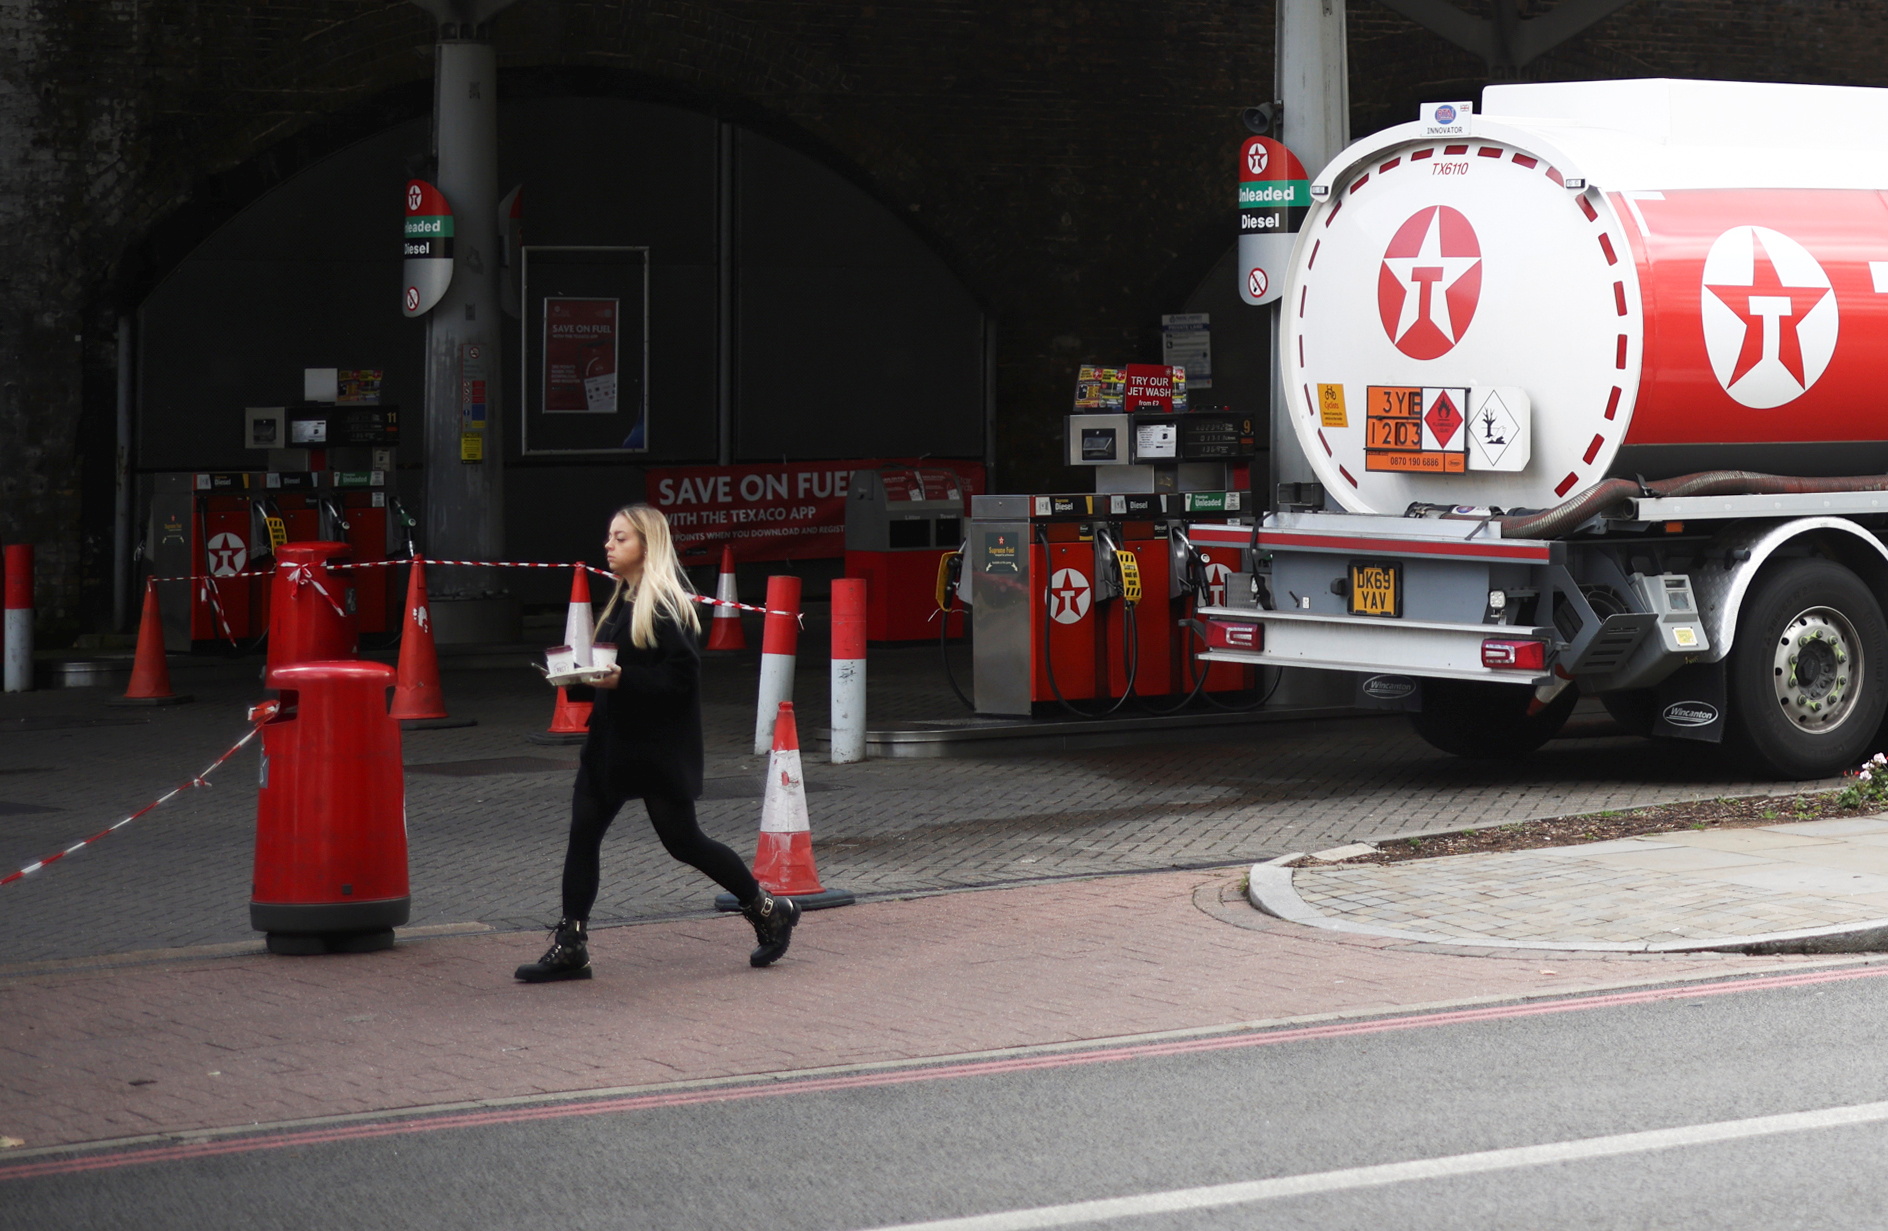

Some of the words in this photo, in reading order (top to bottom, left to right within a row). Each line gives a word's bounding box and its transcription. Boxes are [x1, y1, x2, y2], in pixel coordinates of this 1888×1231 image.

[1427, 126, 1464, 135] INNOVATOR
[1432, 162, 1469, 176] TX6110
[1241, 213, 1280, 229] Diesel
[552, 324, 575, 334] SAVE
[576, 324, 591, 334] ON
[592, 324, 613, 334] FUEL
[1131, 375, 1149, 386] TRY
[1150, 376, 1169, 387] OUR
[1127, 387, 1144, 397] JET
[1145, 387, 1172, 398] WASH
[1138, 399, 1151, 407] from
[1383, 391, 1421, 416] 3YE
[387, 412, 398, 424] 11
[1243, 420, 1252, 434] 9
[1371, 422, 1421, 446] 1203
[1390, 456, 1407, 466] 0870
[1408, 457, 1421, 466] 190
[1422, 458, 1439, 467] 6886
[658, 476, 733, 506] SAVE
[740, 473, 790, 502] ON
[797, 470, 856, 499] FUE
[1055, 502, 1074, 511] Diesel
[1129, 500, 1149, 509] Diesel
[1195, 498, 1222, 508] Unleaded
[701, 510, 727, 525] THE
[731, 507, 787, 524] TEXACO
[790, 506, 817, 520] APP
[675, 532, 706, 542] POINTS
[706, 530, 732, 541] WHEN
[733, 528, 750, 539] YOU
[751, 526, 801, 538] DOWNLOAD
[802, 525, 818, 536] AND
[1357, 571, 1391, 590] DK69
[1361, 591, 1387, 609] YAV
[1370, 680, 1412, 691] Wincanton
[1671, 706, 1714, 719] Wincanton
